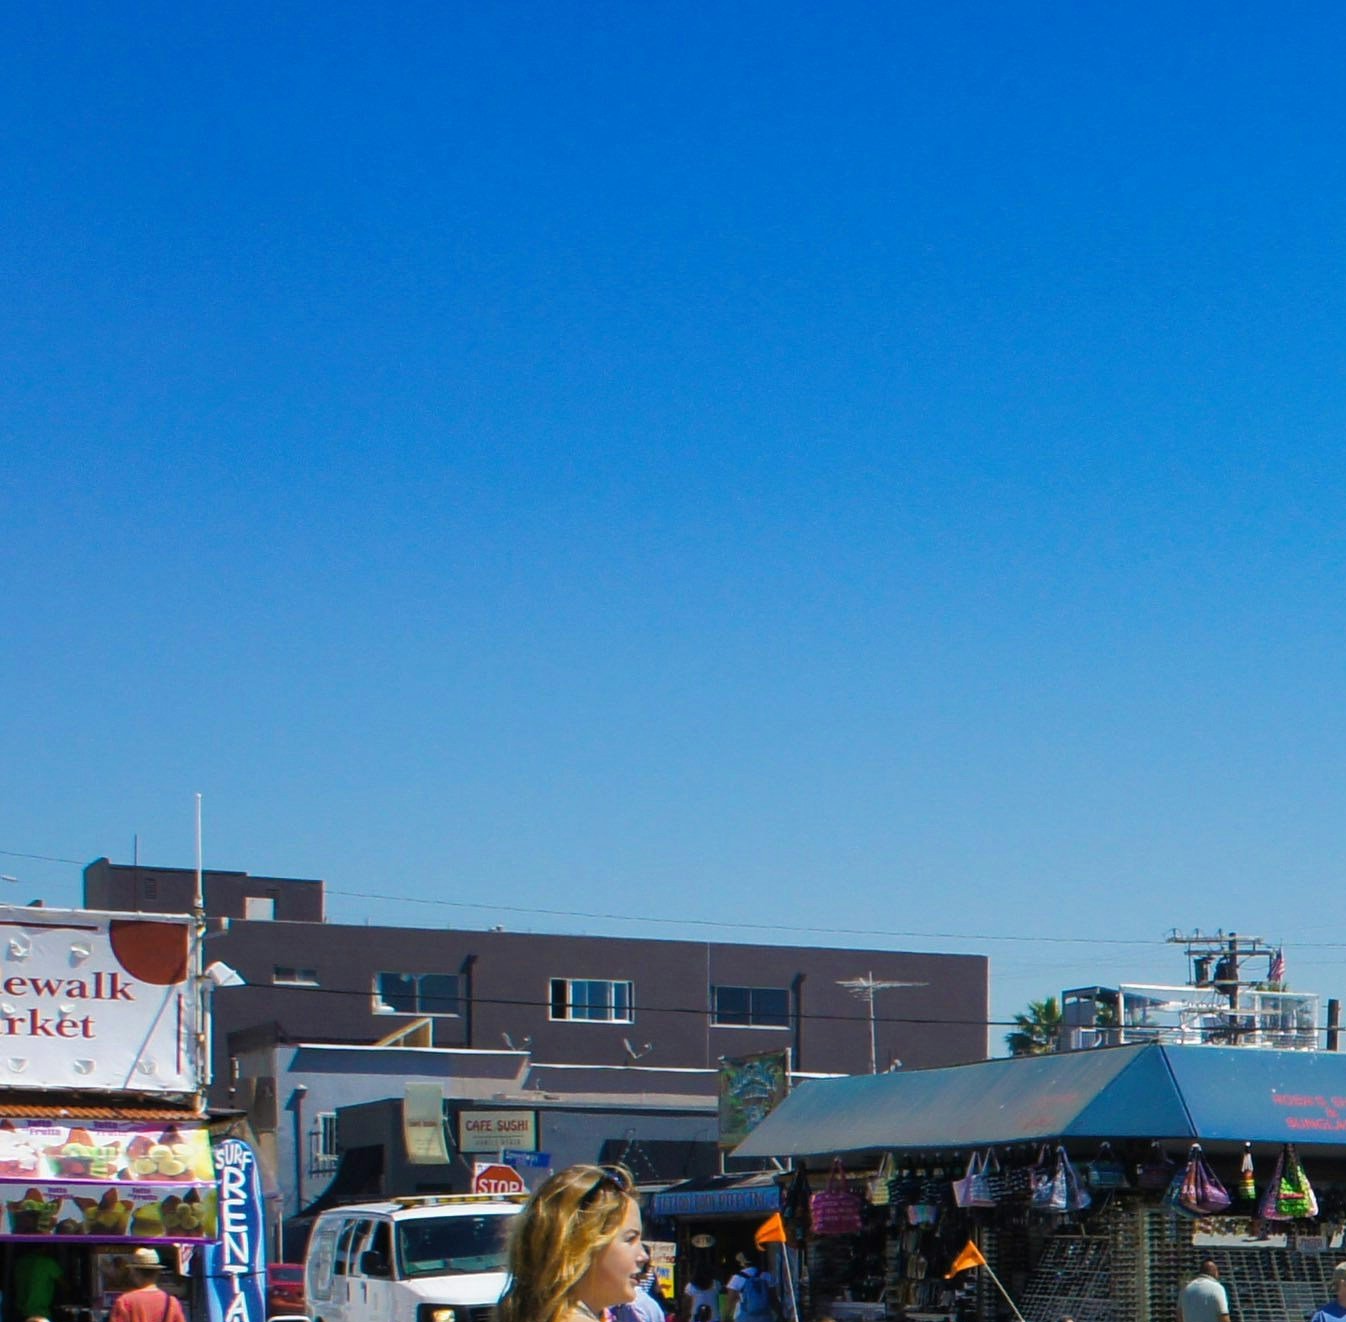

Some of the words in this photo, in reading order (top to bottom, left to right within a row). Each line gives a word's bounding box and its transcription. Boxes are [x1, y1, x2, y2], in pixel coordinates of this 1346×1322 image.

[0, 972, 136, 1001] ewalk
[0, 1008, 96, 1039] rket
[466, 1120, 492, 1131] CAFE
[497, 1120, 529, 1131] SUSHI
[215, 1143, 252, 1170] SURF
[479, 1178, 520, 1193] STOP
